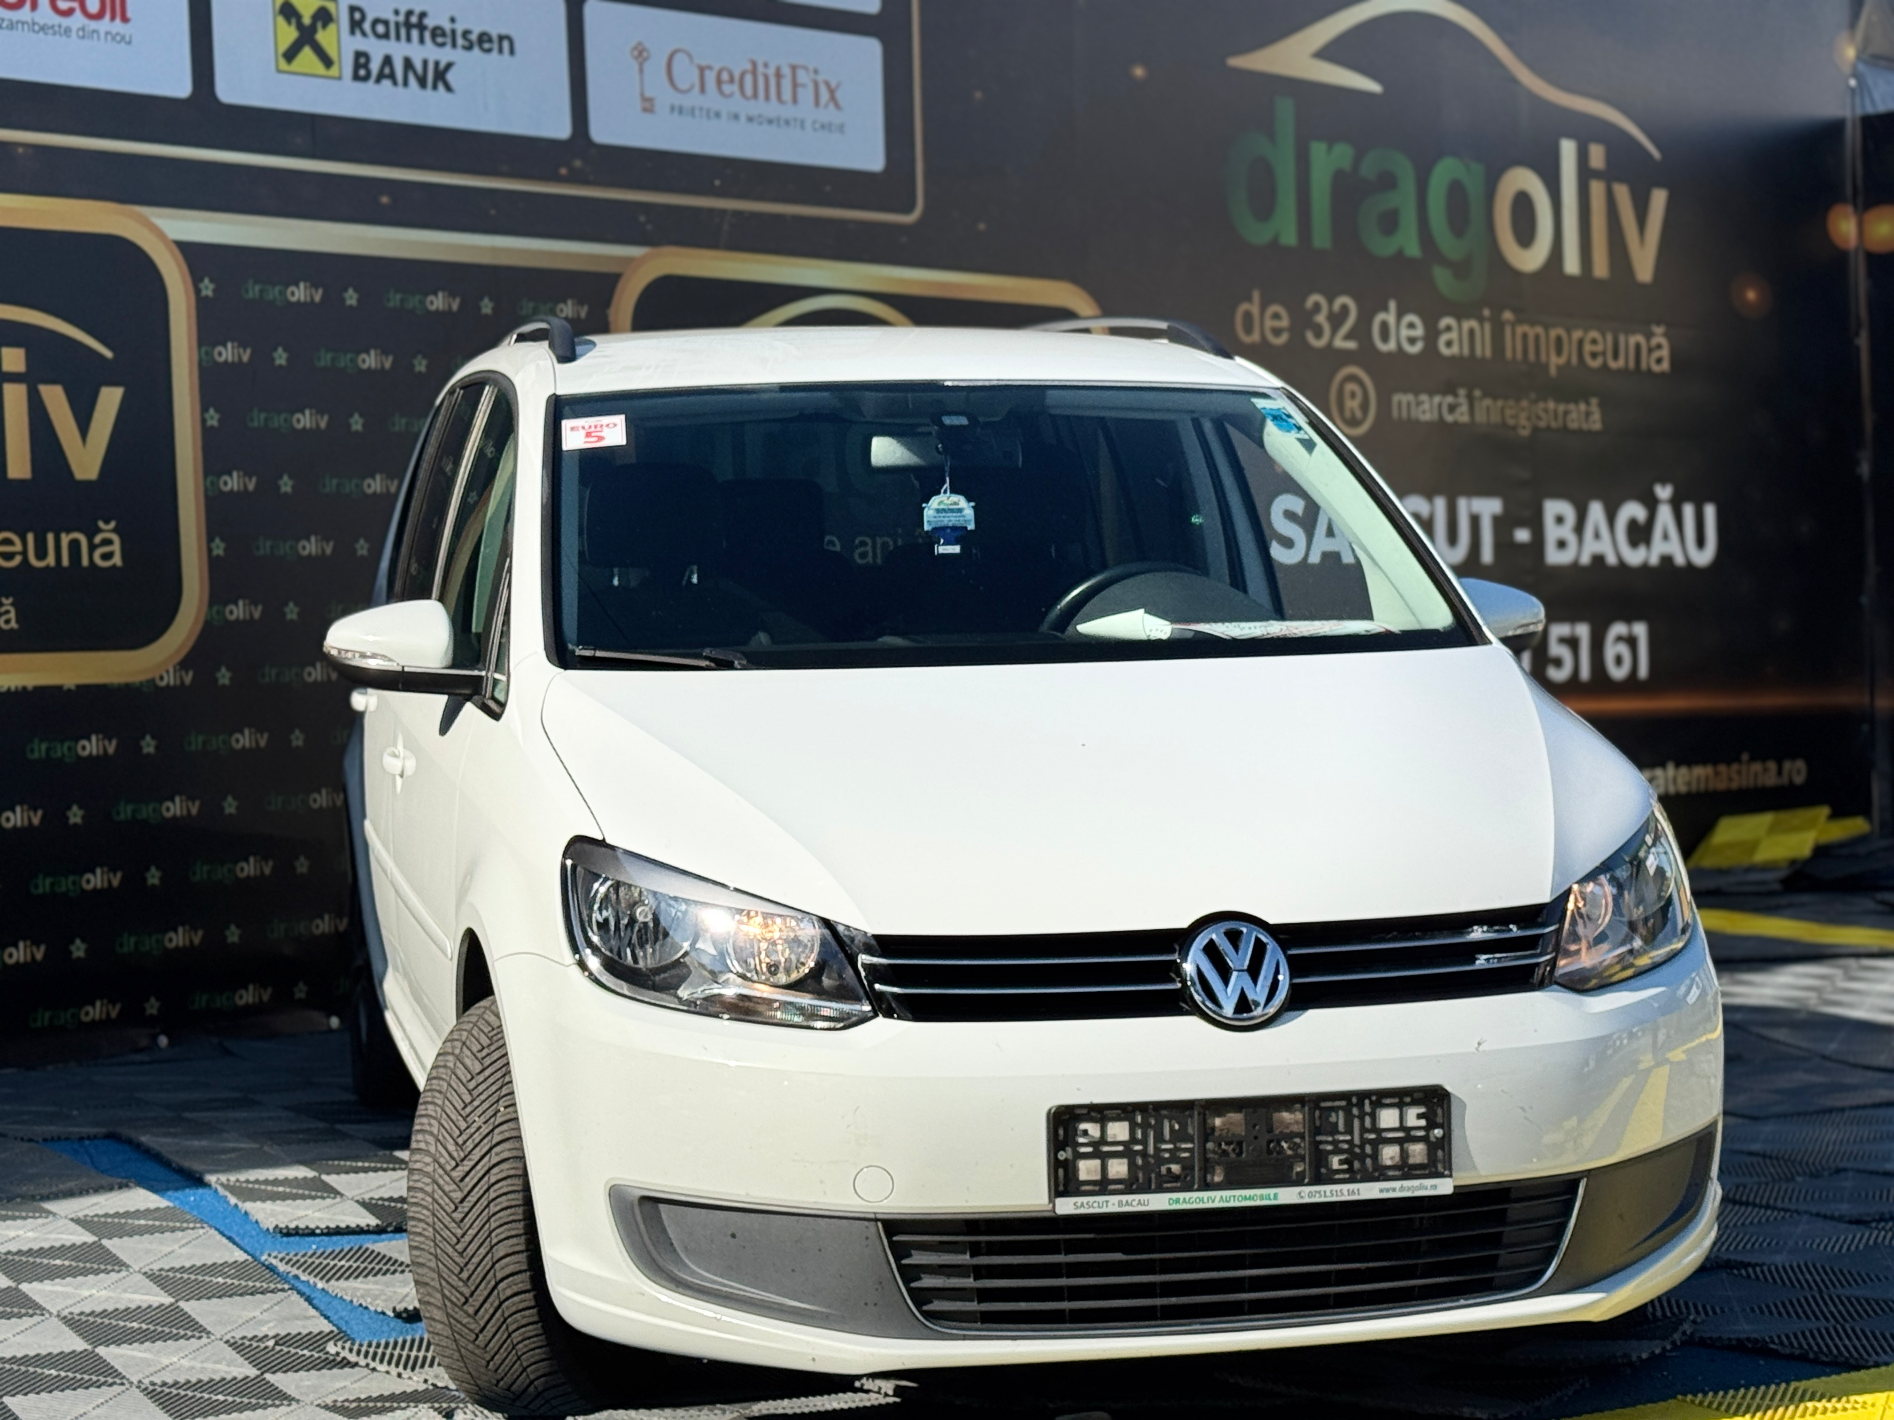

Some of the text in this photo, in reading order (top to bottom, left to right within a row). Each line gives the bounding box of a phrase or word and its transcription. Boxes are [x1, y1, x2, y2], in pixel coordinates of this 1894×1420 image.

[0, 17, 133, 46] zambeste din nou
[348, 5, 516, 57] Raiffeisen
[352, 50, 457, 94] BANK
[665, 48, 843, 110] CreditFix
[669, 103, 722, 121] PRIETEN
[726, 110, 741, 122] IN
[1225, 95, 1669, 303] dragoliv
[241, 279, 324, 306] dragoliv
[384, 287, 462, 315] dragoliv
[1234, 289, 1672, 377] de 32 de ani împreună
[314, 348, 394, 374] dragoliv
[247, 408, 329, 432] dragoliv
[1392, 387, 1470, 424] marcă
[569, 421, 619, 433] EURO
[583, 430, 606, 445] 5
[206, 470, 400, 498] goliv dragoliv
[1513, 526, 1530, 543] -
[1541, 484, 1718, 568] BACĂU
[253, 535, 334, 561] dragoliv
[1545, 622, 1592, 683] 51
[1603, 620, 1651, 681] 61
[25, 727, 269, 762] dragoliv dragoliv
[111, 794, 201, 825] dragoliv
[29, 855, 274, 897] dragoliv dragoliv
[115, 925, 205, 955] dragoliv
[28, 983, 274, 1029] dragoliv dragoliv
[1073, 1200, 1109, 1211] SASCUT
[1118, 1198, 1150, 1208] BACAU
[1168, 1196, 1216, 1206] DRAGOLIV
[1218, 1192, 1279, 1204] AUTOMOBILE
